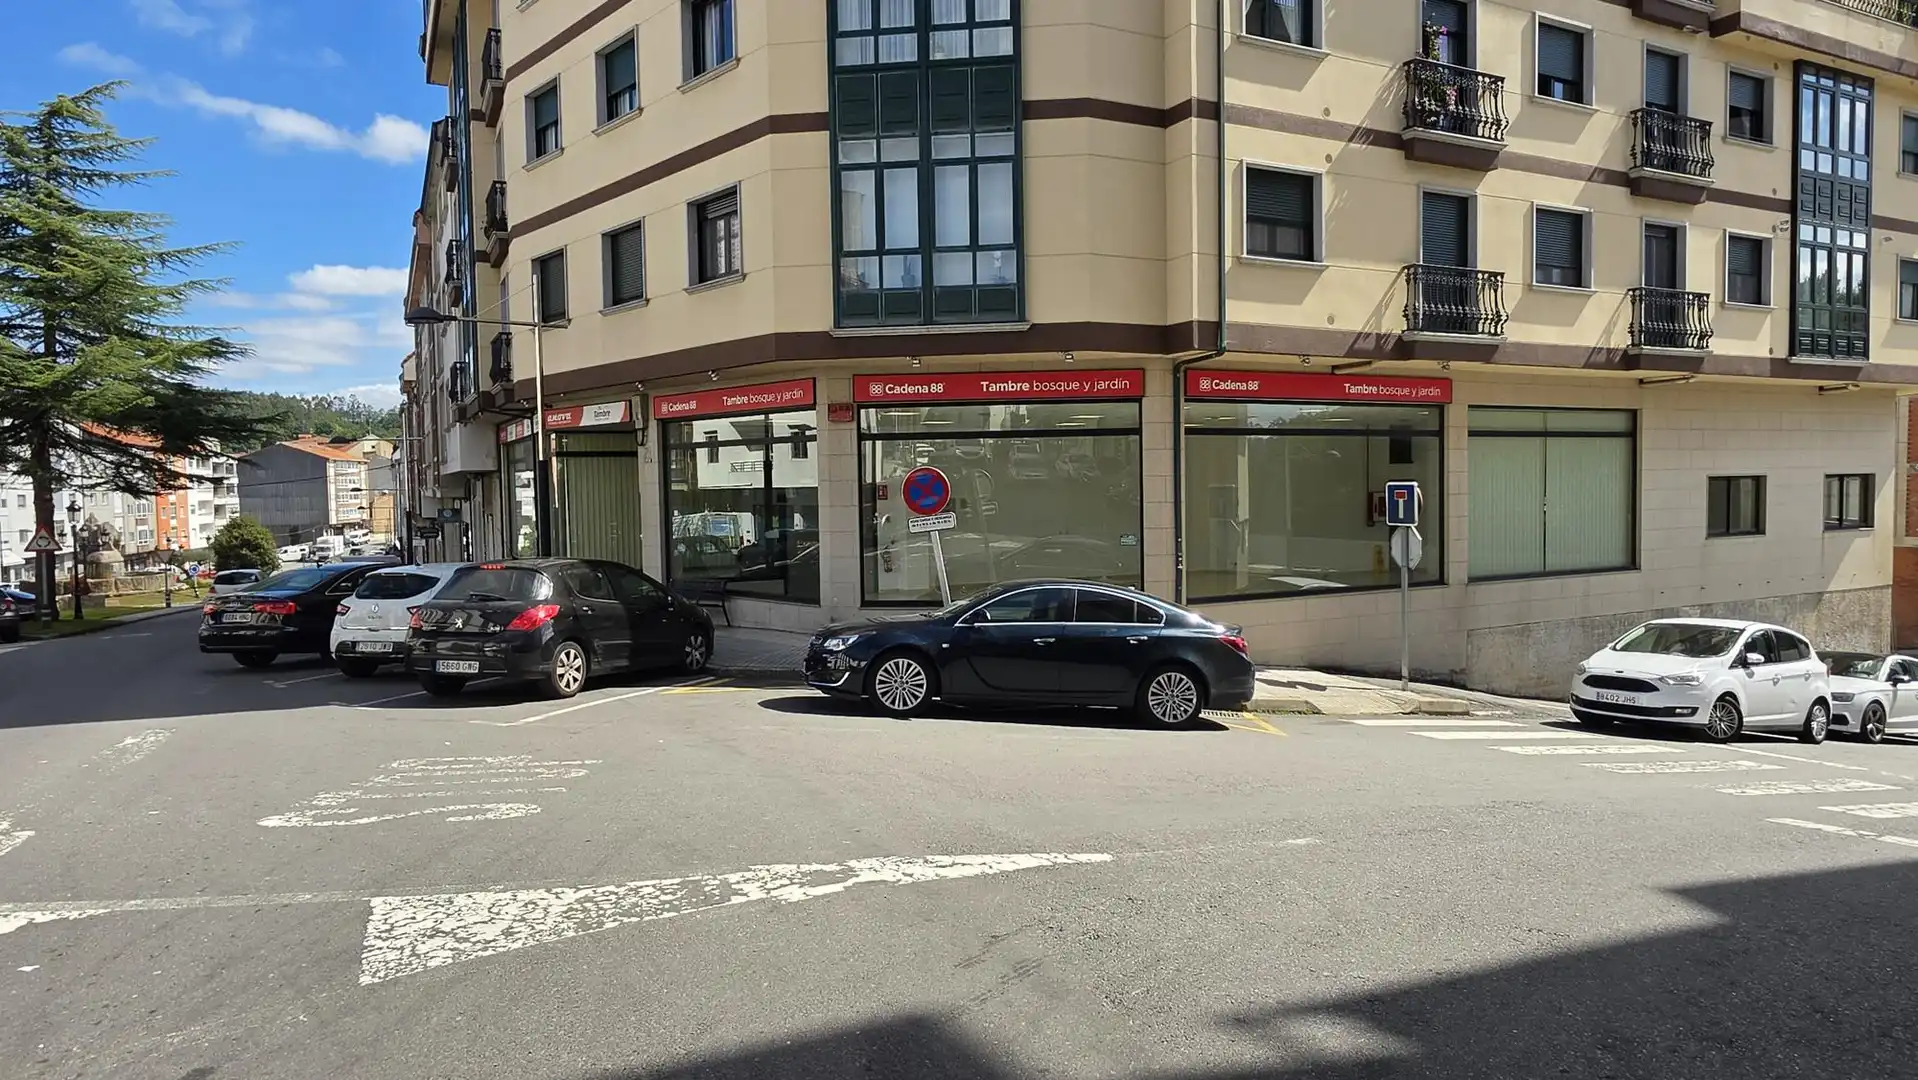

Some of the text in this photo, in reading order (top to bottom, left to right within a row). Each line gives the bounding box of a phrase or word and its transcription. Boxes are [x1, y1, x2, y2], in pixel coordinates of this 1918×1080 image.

[885, 383, 929, 394] Cadena
[930, 383, 944, 393] 88
[981, 377, 1130, 392] Tambre bosque y jardín
[1212, 380, 1247, 391] Cadena
[1247, 380, 1259, 390] 88
[1344, 383, 1441, 398] Tambre bosque y jardín
[722, 388, 804, 406] Tambre bosque y jardín
[669, 401, 690, 411] Cadena
[690, 400, 697, 410] 88
